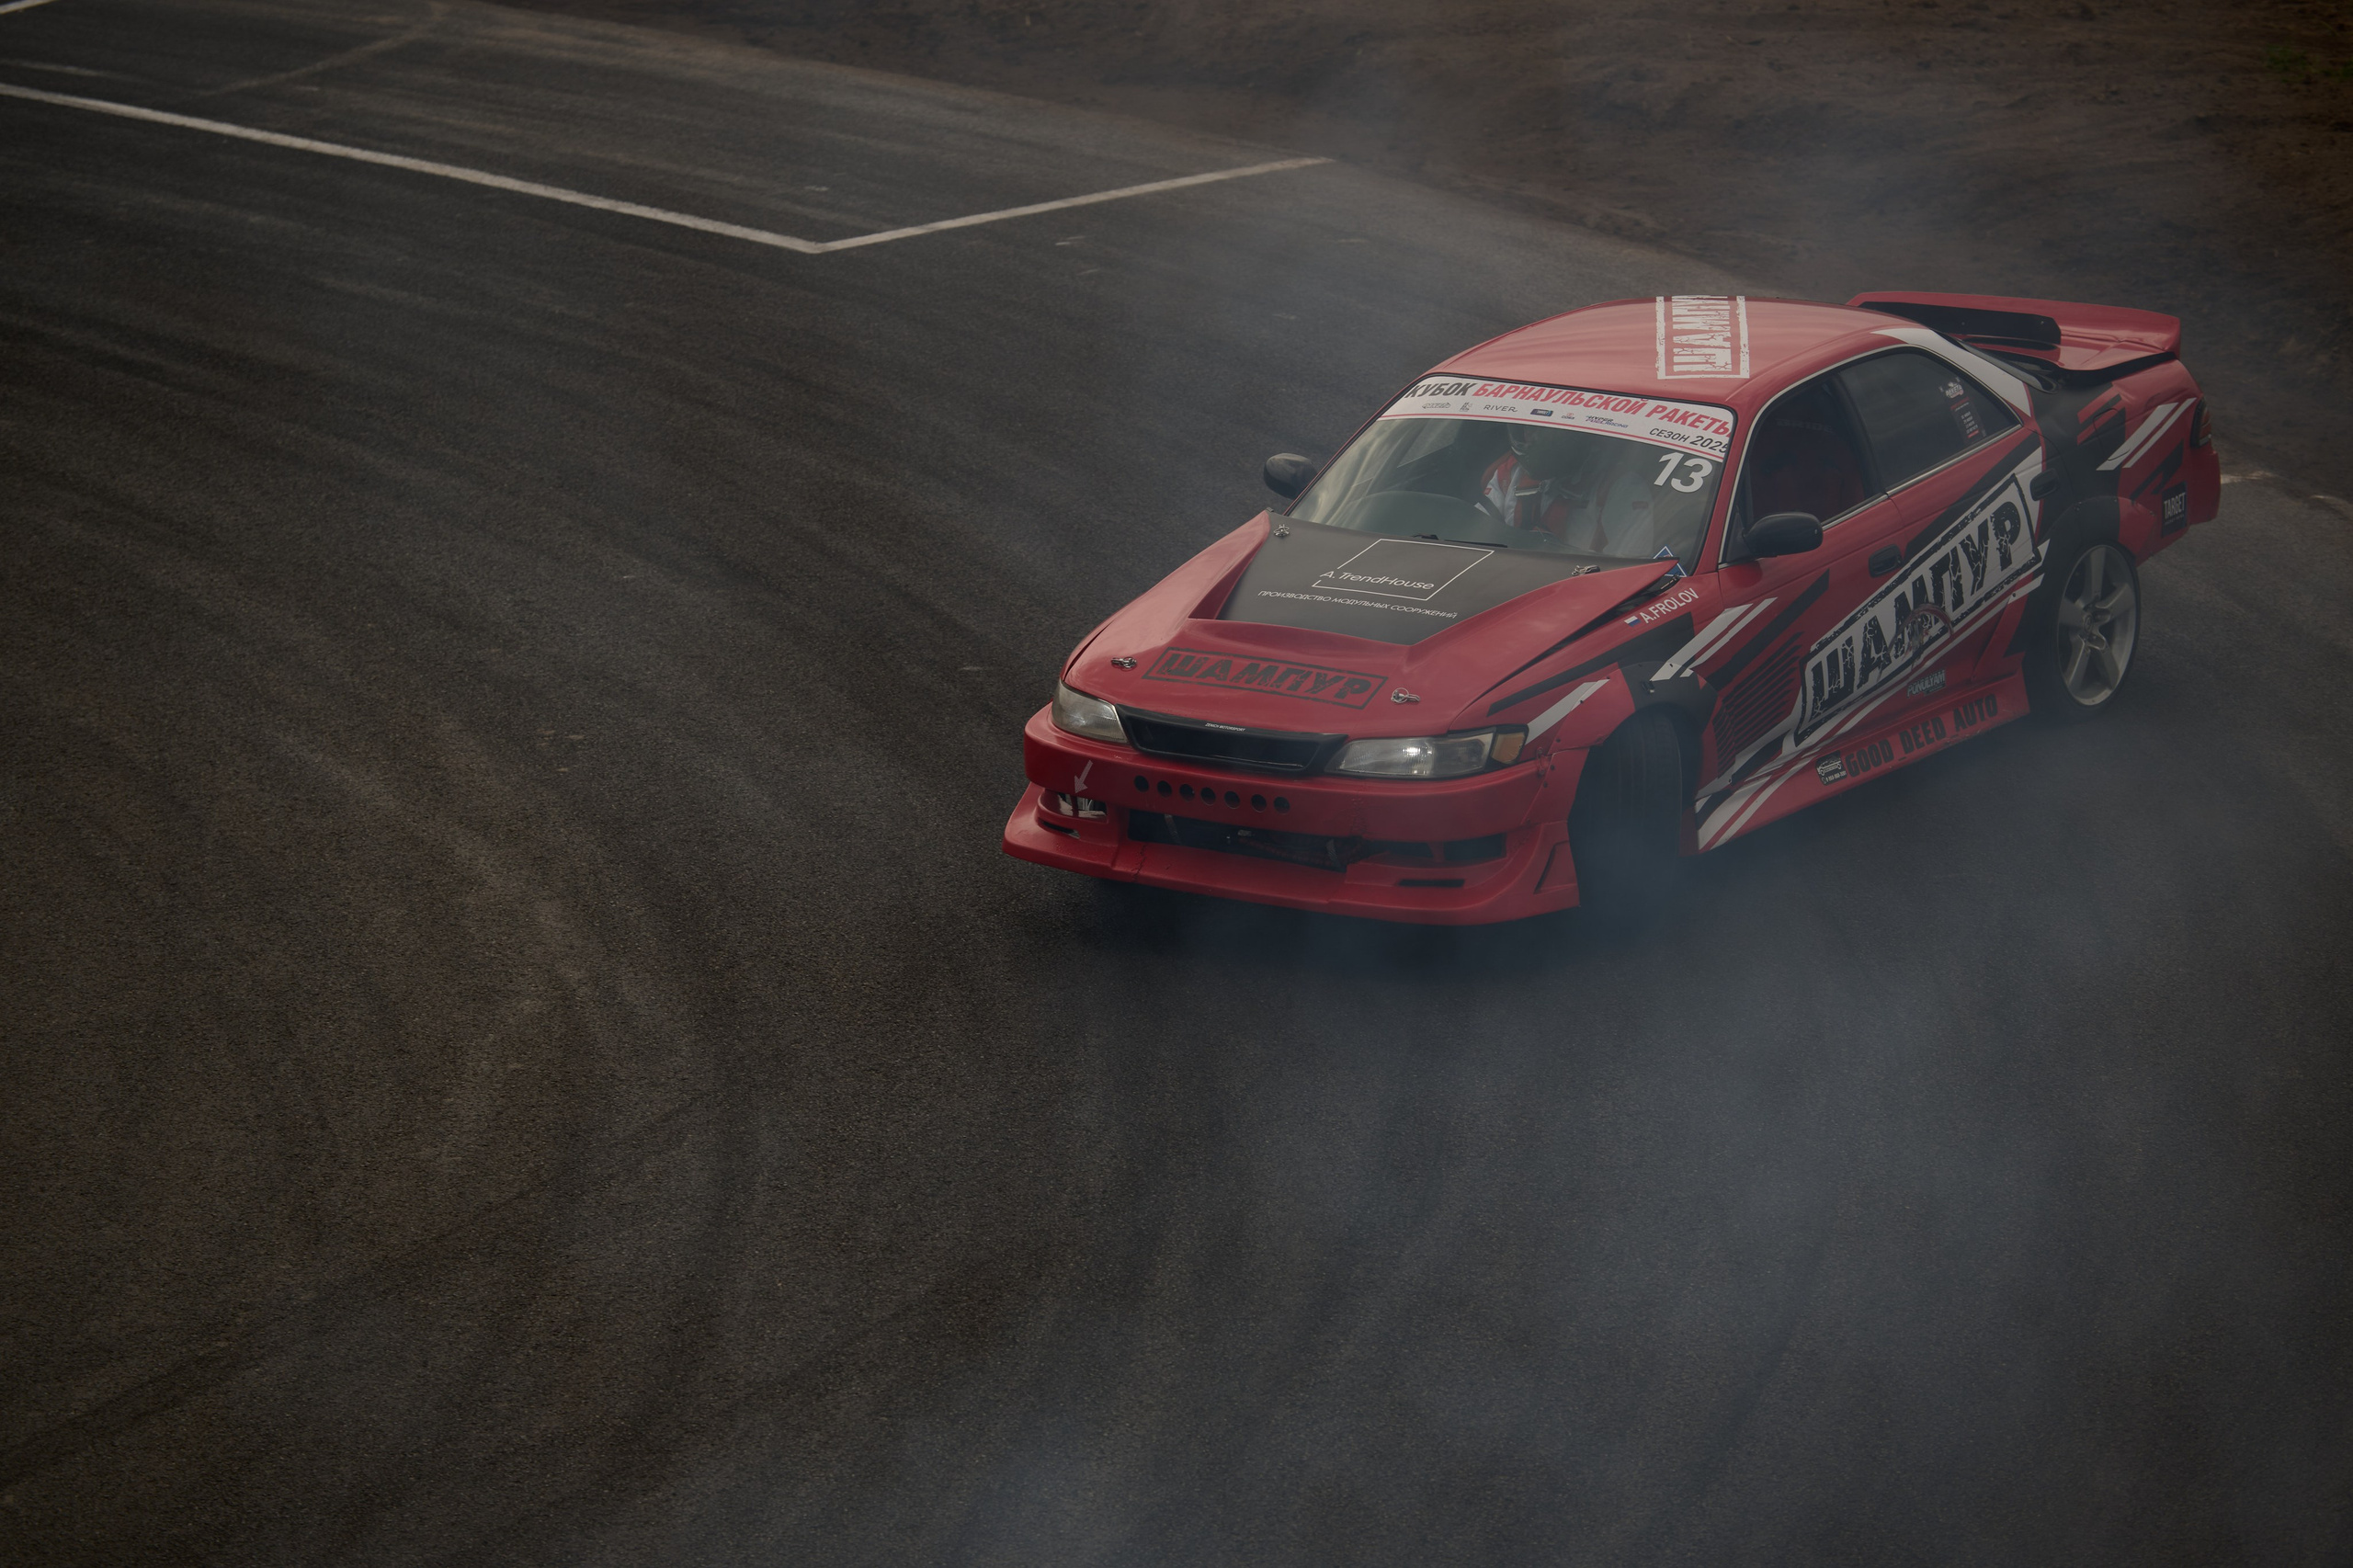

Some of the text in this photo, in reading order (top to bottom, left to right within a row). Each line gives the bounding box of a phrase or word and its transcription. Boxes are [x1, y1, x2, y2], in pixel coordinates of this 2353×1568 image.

[1404, 382, 1477, 398] КУБОК
[1472, 382, 1646, 415] БАРНАУЛЬСКОЙ
[1483, 404, 1518, 413] RIVER
[1649, 427, 1690, 442] СЕЗОН
[1654, 452, 1713, 493] 13
[2164, 492, 2186, 519] TARGET
[1320, 570, 1435, 590] A. TrendHouse
[1257, 590, 1458, 619] ПРОИЗВОДСТВО МОДУЛЬНЫХ СООРУЖЕНИЙ
[1640, 588, 1699, 623] A.FROLOV
[1810, 501, 2021, 722] ШАМПУР
[1159, 653, 1373, 700] ШАМПУР
